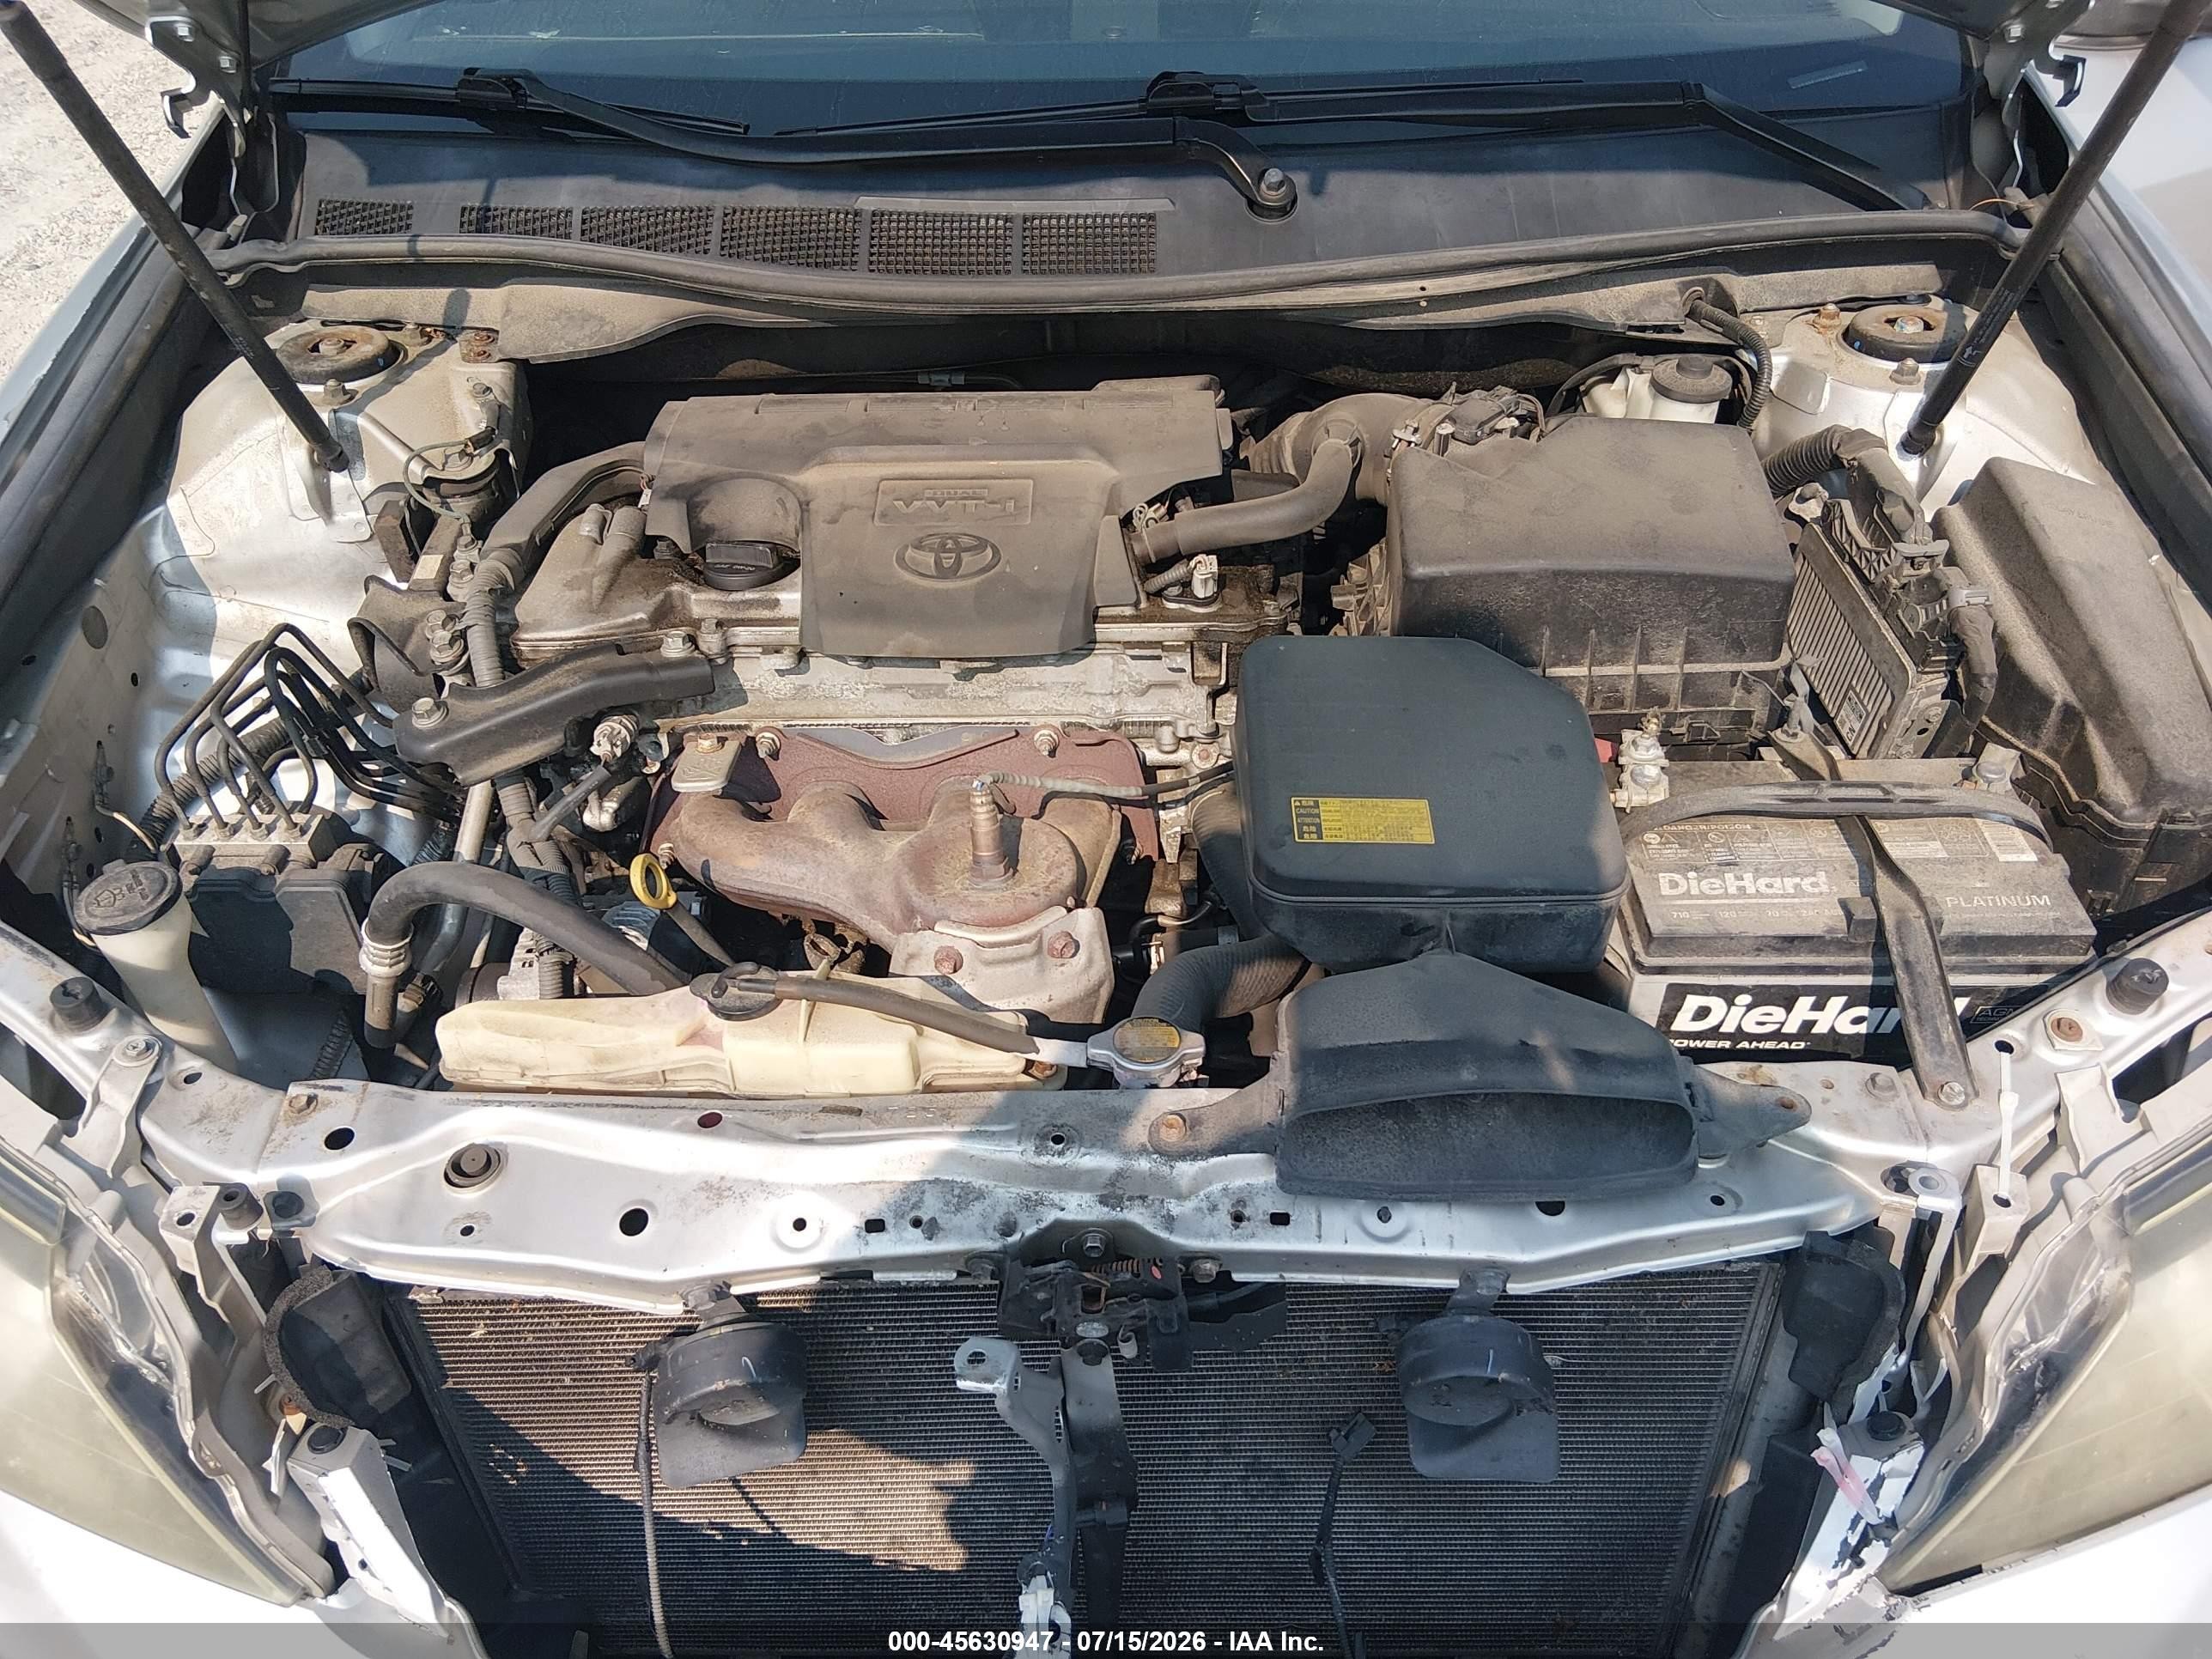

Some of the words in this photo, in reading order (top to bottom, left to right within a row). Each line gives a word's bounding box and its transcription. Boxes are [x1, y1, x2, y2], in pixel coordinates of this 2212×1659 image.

[1658, 871, 1830, 896] DieHard
[1945, 895, 2051, 908] PLATINUM
[1670, 1039, 1732, 1048] OWER
